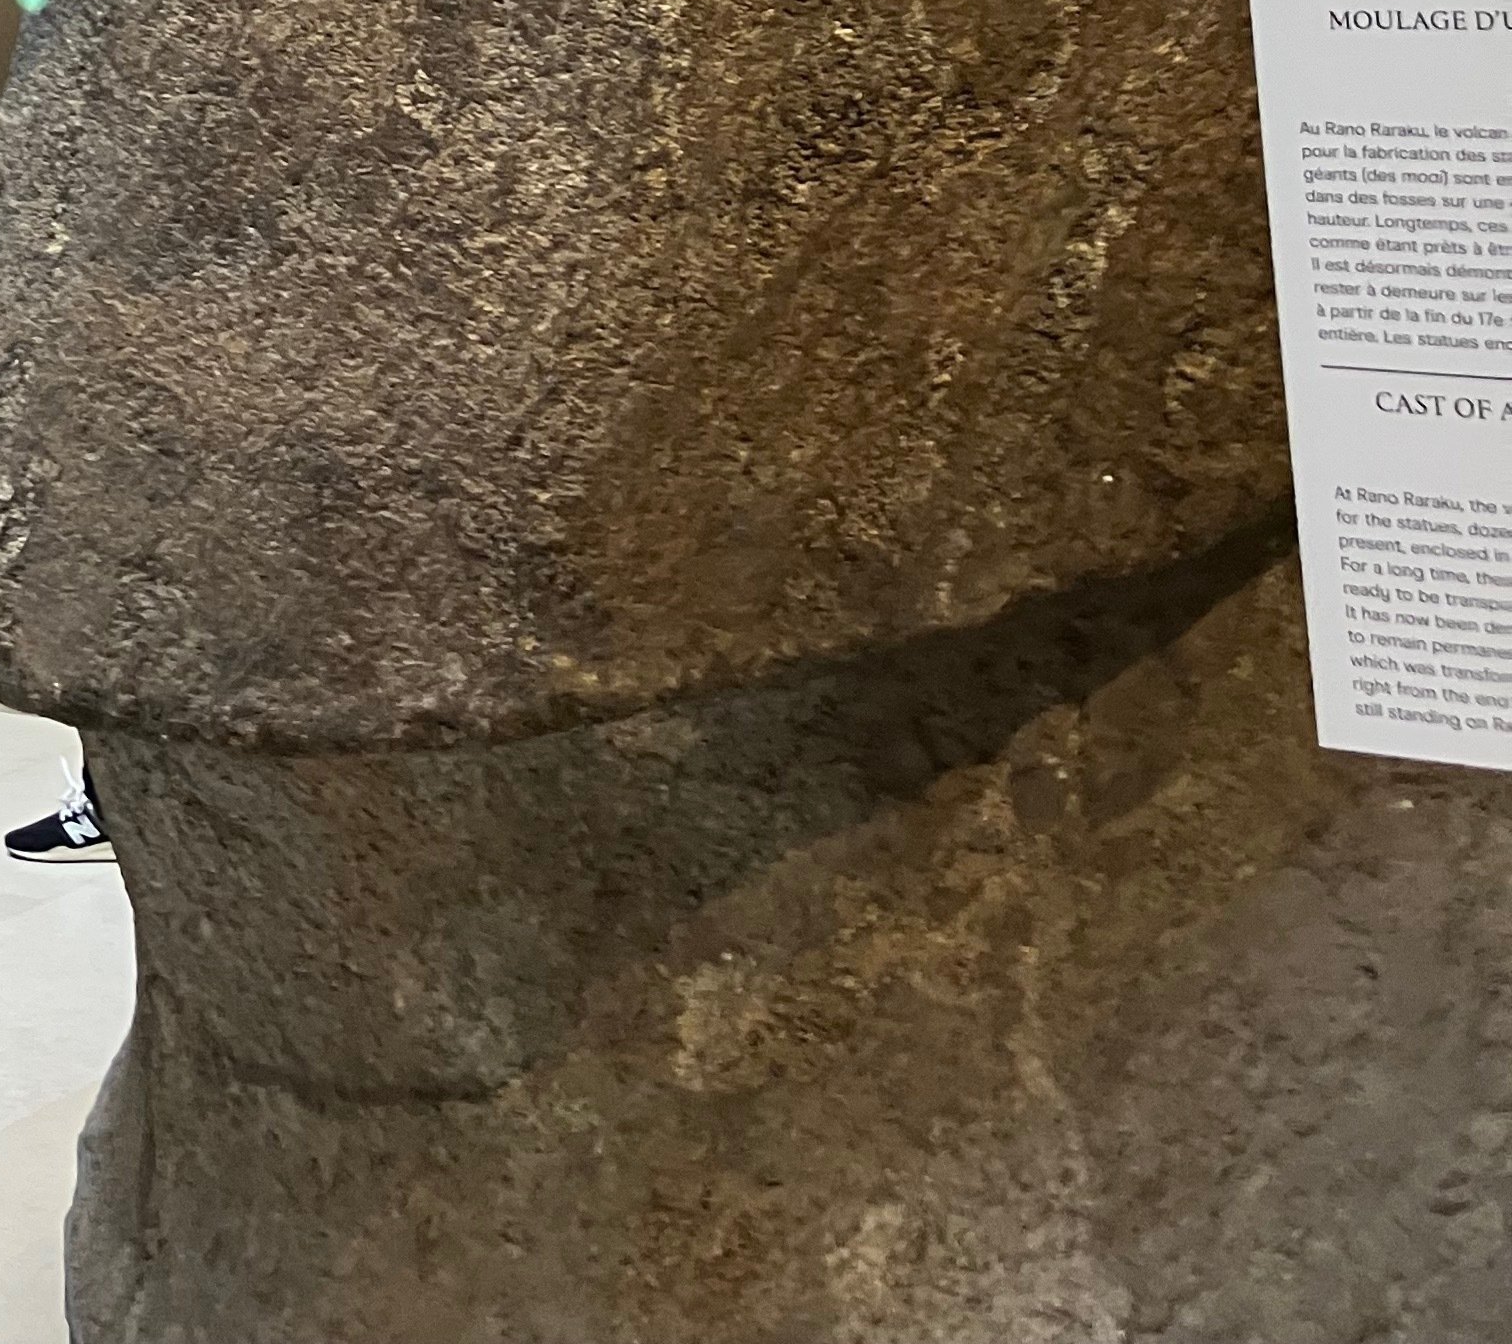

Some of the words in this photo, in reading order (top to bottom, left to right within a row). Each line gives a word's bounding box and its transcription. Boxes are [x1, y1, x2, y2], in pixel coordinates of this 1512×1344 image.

[1329, 10, 1467, 30] MOULAGE
[1300, 122, 1320, 134] Au
[1326, 121, 1365, 136] Rano
[1435, 124, 1448, 138] le
[1302, 146, 1338, 160] pour
[1344, 145, 1357, 158] la
[1362, 145, 1450, 161] fabrication
[1456, 148, 1486, 161] des
[1303, 167, 1357, 183] géants
[1362, 167, 1395, 184] (des
[1454, 173, 1490, 185] sont
[1305, 191, 1343, 204] dans
[1348, 191, 1377, 205] des
[1383, 192, 1436, 207] fosses
[1442, 195, 1465, 208] sur
[1473, 197, 1504, 209] une
[1477, 221, 1508, 232] ces
[1309, 237, 1369, 250] comme
[1376, 238, 1417, 252] étant
[1474, 242, 1482, 255] à
[1325, 260, 1349, 272] est
[1355, 259, 1441, 277] désormais
[1314, 283, 1361, 296] rester
[1367, 284, 1376, 296] à
[1381, 286, 1455, 301] demeure
[1462, 290, 1486, 302] sur
[1317, 304, 1326, 317] à
[1331, 306, 1373, 320] partir
[1379, 308, 1400, 321] de
[1406, 309, 1420, 322] la
[1425, 309, 1446, 323] fin
[1451, 312, 1472, 325] du
[1479, 313, 1504, 326] 17e
[1384, 330, 1411, 344] Les
[1418, 334, 1478, 349] statues
[1376, 391, 1445, 416] CAST
[1454, 397, 1491, 419] OF
[1335, 486, 1351, 501] At
[1357, 488, 1399, 505] Rano
[1469, 499, 1496, 514] the
[1337, 509, 1359, 524] for
[1365, 513, 1391, 528] the
[1411, 543, 1489, 561] enclosed
[1495, 548, 1509, 561] in
[1341, 556, 1367, 572] For
[1374, 563, 1382, 574] a
[1388, 561, 1424, 582] long
[1343, 583, 1390, 602] ready
[1396, 588, 1413, 601] to
[1419, 589, 1439, 604] be
[1346, 604, 1356, 619] It
[1362, 607, 1390, 622] has
[1396, 613, 1429, 626] now
[1435, 615, 1479, 632] been
[1348, 630, 1365, 643] to
[1370, 633, 1427, 650] remain
[1350, 654, 1399, 672] which
[1403, 662, 1435, 676] was
[1353, 678, 1391, 696] right
[1397, 682, 1436, 699] from
[1443, 688, 1469, 703] the
[1356, 703, 1383, 716] still
[1388, 706, 1462, 730] standing
[63, 814, 101, 845] N
